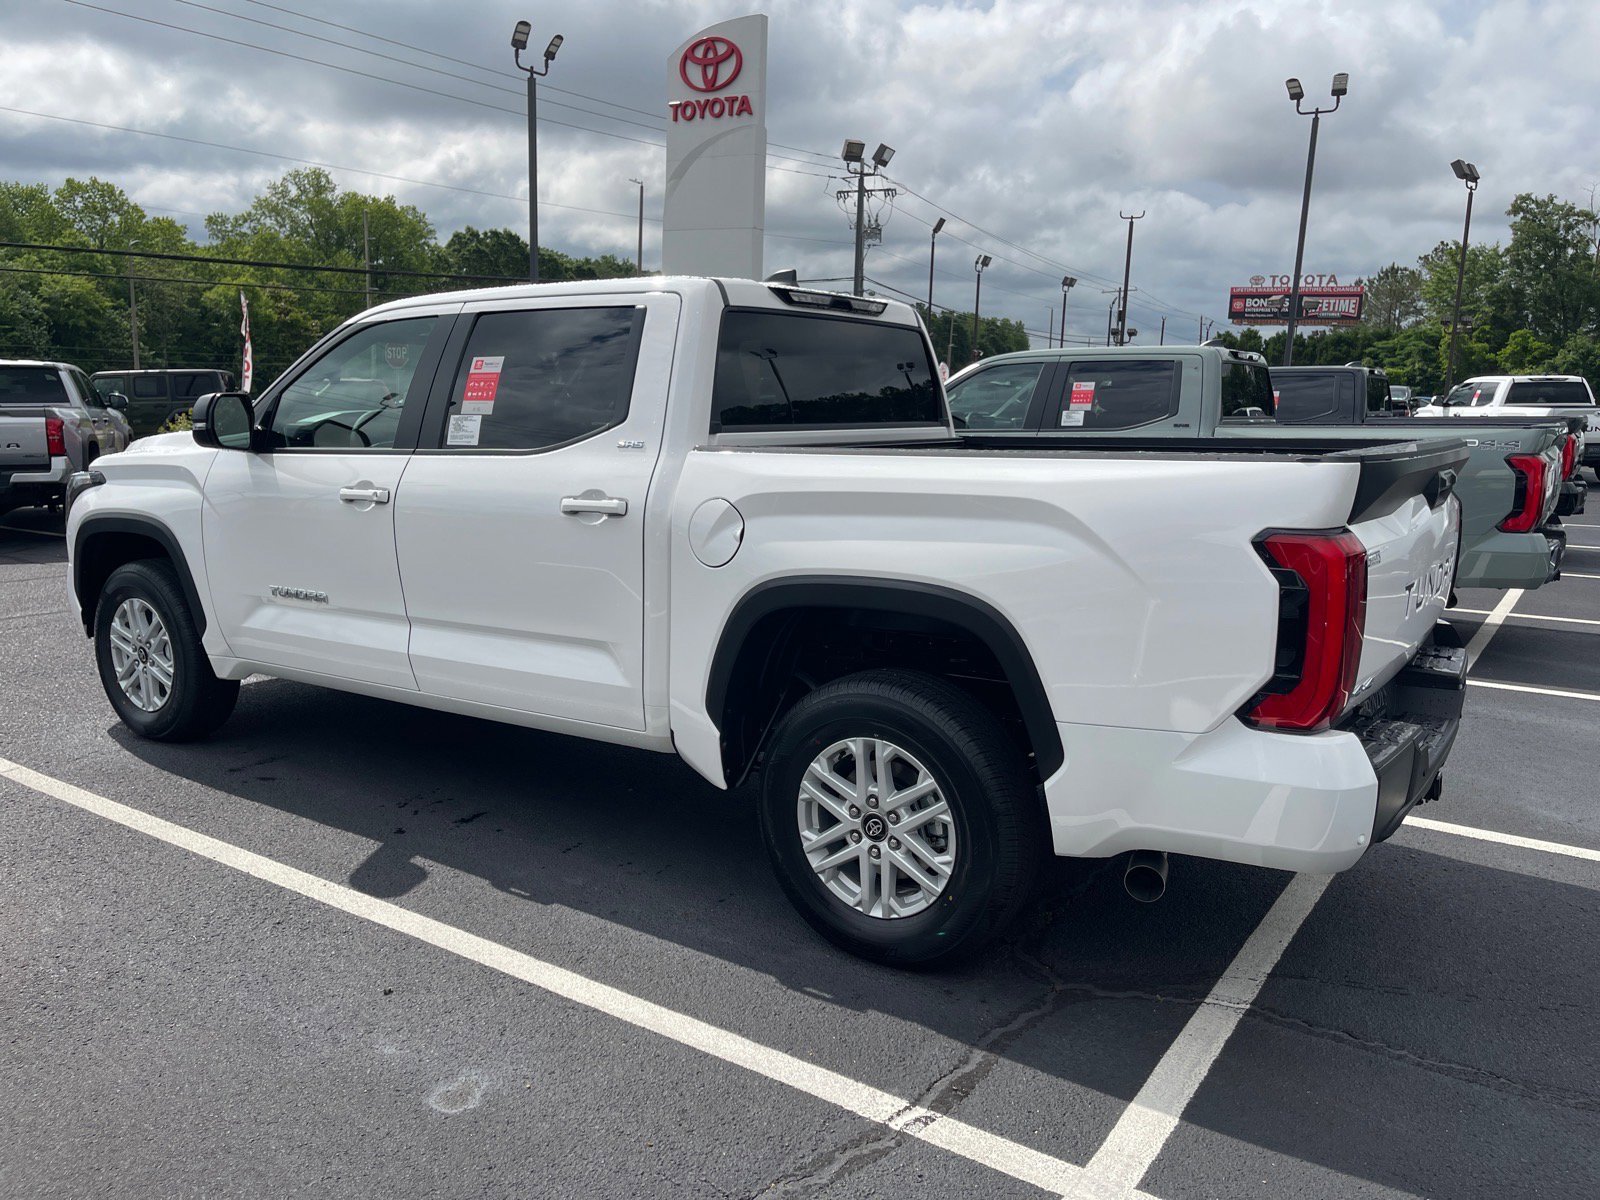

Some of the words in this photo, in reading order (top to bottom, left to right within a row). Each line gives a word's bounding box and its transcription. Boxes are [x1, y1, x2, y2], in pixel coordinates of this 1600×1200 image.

[668, 95, 753, 122] TOYOTA
[1269, 274, 1338, 286] TOOTA
[1245, 298, 1290, 307] BONS
[387, 346, 408, 360] STOP
[269, 585, 329, 604] TUNDRA
